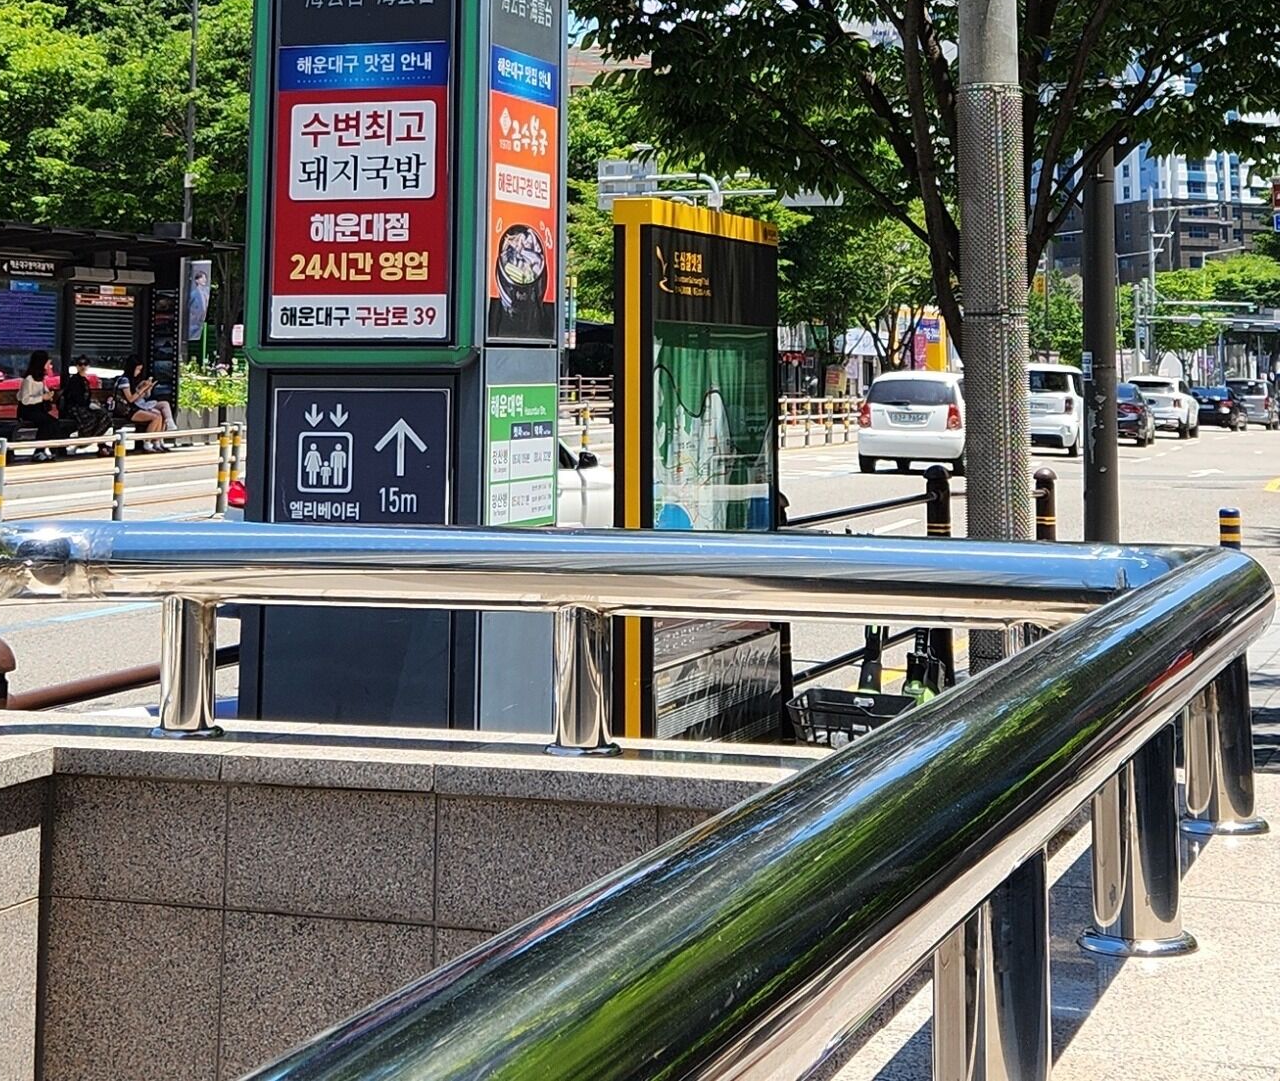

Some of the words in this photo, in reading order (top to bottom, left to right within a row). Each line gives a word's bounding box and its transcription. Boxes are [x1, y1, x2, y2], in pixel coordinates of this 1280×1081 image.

[296, 54, 360, 75] 해운대구
[364, 53, 395, 72] 맛집
[400, 52, 433, 71] 안내
[497, 57, 524, 81] 해운대구
[525, 66, 538, 86] 맛집
[301, 109, 426, 148] 수변최고
[298, 153, 427, 192] 돼지국밥
[498, 172, 533, 198] 해운대구청
[534, 179, 548, 200] 인근
[310, 212, 410, 243] 해운대점
[289, 252, 373, 281] 24시간
[378, 251, 430, 281] 영업
[280, 306, 351, 327] 해운대구
[355, 306, 409, 327] 구남로
[413, 307, 437, 326] 39
[490, 394, 524, 418] 해운대역
[289, 500, 360, 521] 엘리베이터
[378, 486, 418, 513] 15m
